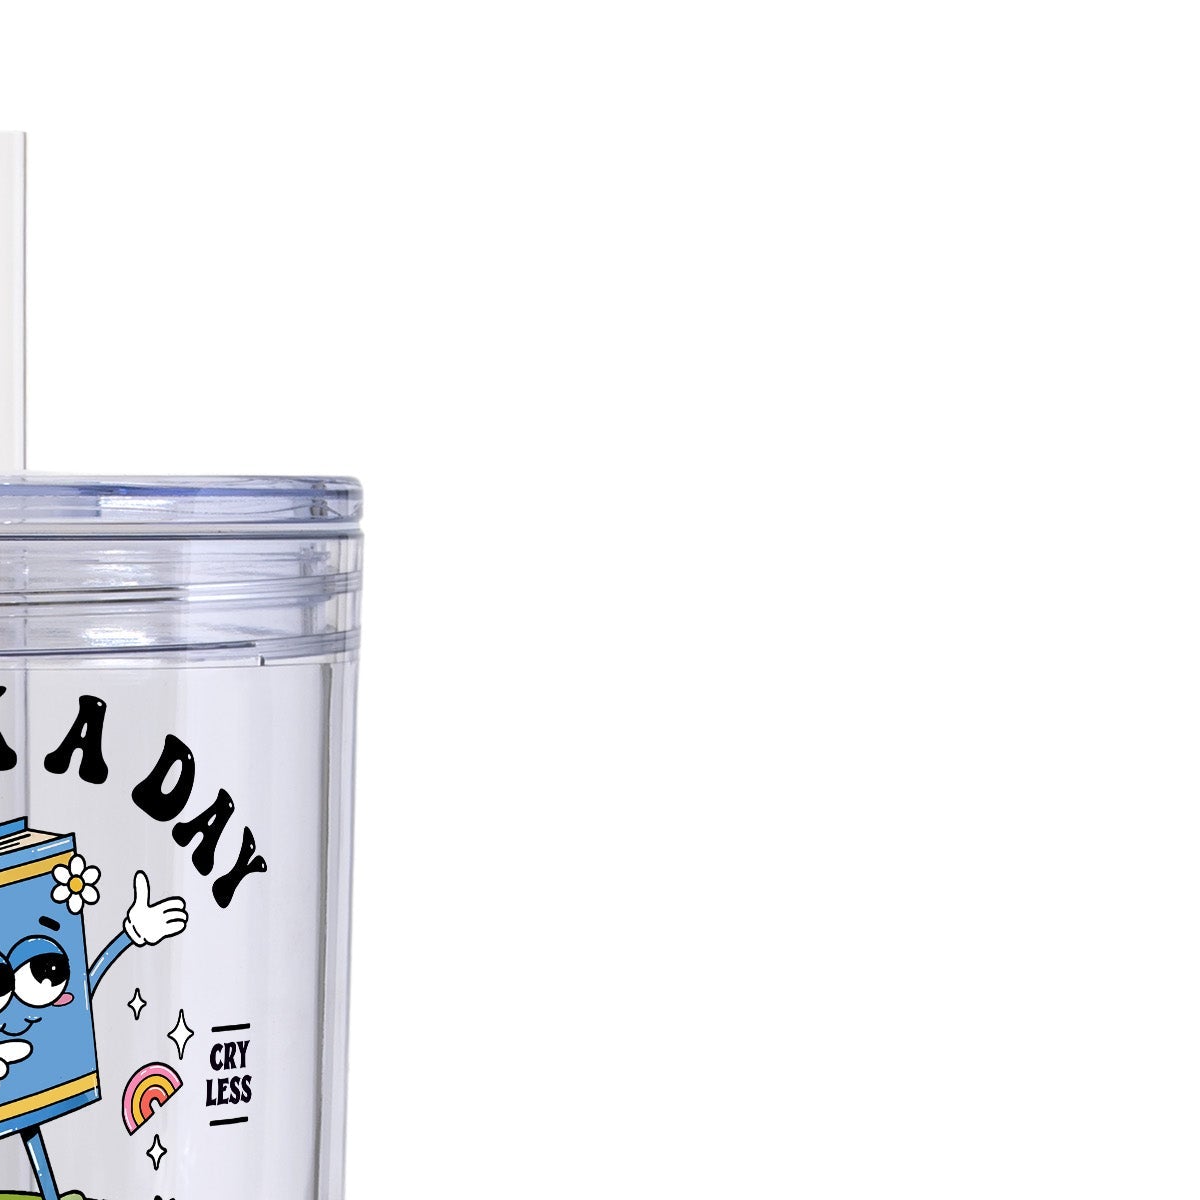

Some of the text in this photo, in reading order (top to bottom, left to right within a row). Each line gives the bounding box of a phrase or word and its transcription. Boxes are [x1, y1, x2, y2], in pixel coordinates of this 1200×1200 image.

[43, 694, 109, 785] A
[131, 733, 268, 909] DAY
[209, 1039, 251, 1072] CRY
[205, 1074, 253, 1107] LESS
